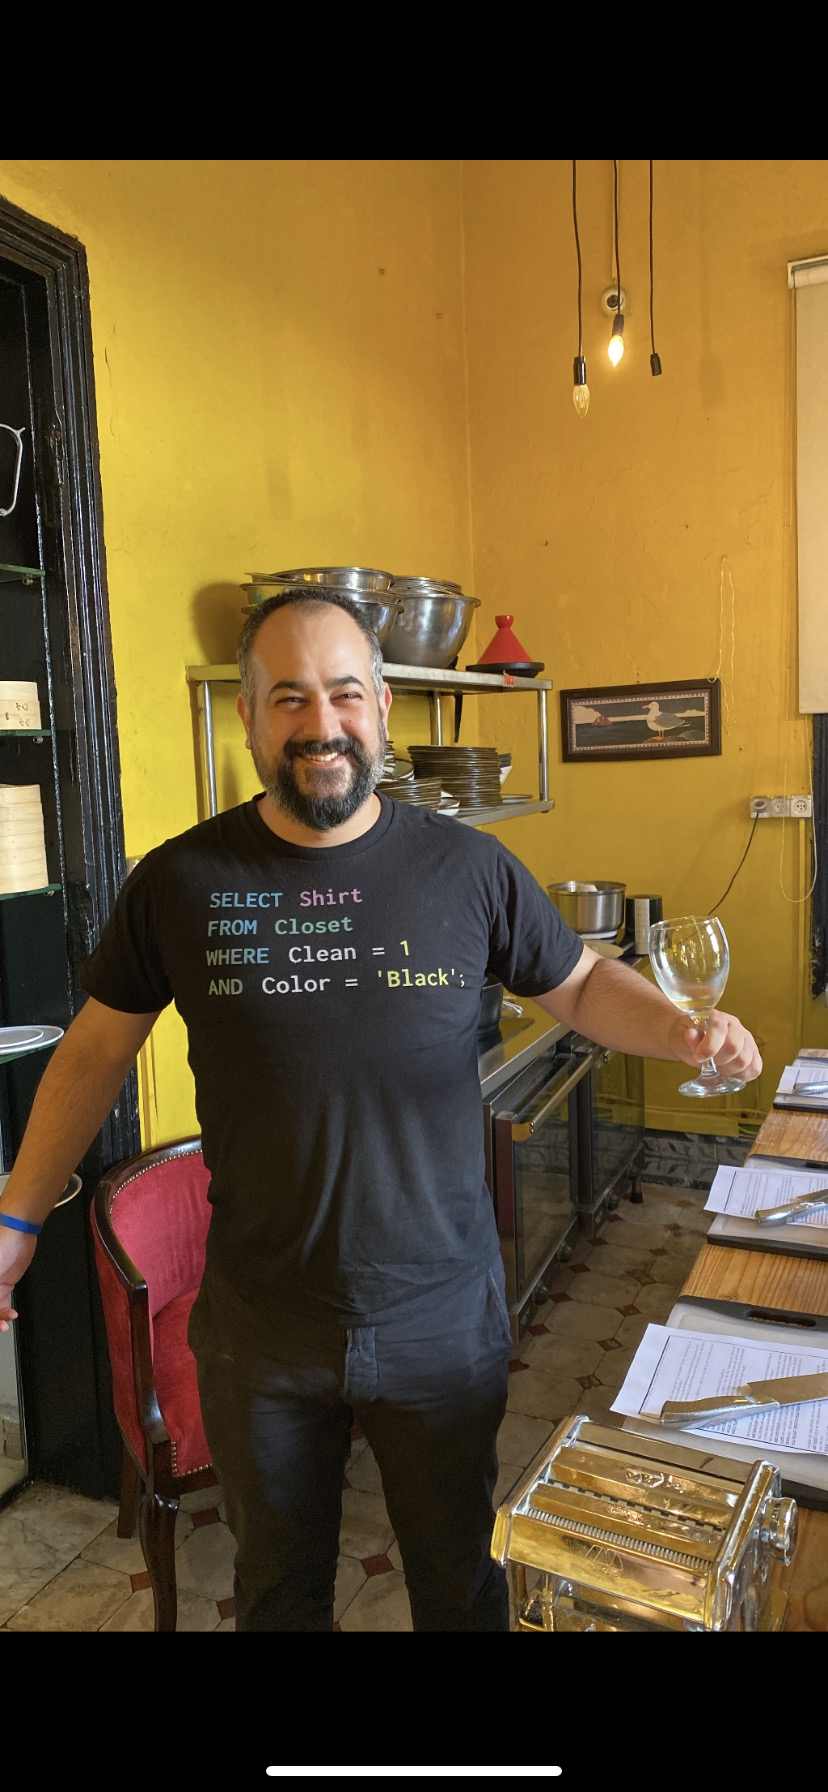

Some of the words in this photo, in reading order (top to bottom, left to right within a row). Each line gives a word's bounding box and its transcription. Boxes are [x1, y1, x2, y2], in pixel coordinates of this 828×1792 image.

[209, 892, 283, 908] SELECT
[300, 888, 363, 907] Shirt
[207, 919, 258, 937] FROM
[274, 916, 353, 935] Closet
[206, 948, 270, 966] WHERE
[288, 945, 357, 963] Clean
[372, 947, 385, 956] =
[400, 940, 410, 956] 1
[208, 979, 243, 995] AND
[261, 975, 331, 994] Color
[345, 978, 359, 988] =
[377, 968, 465, 988] 'Black';
